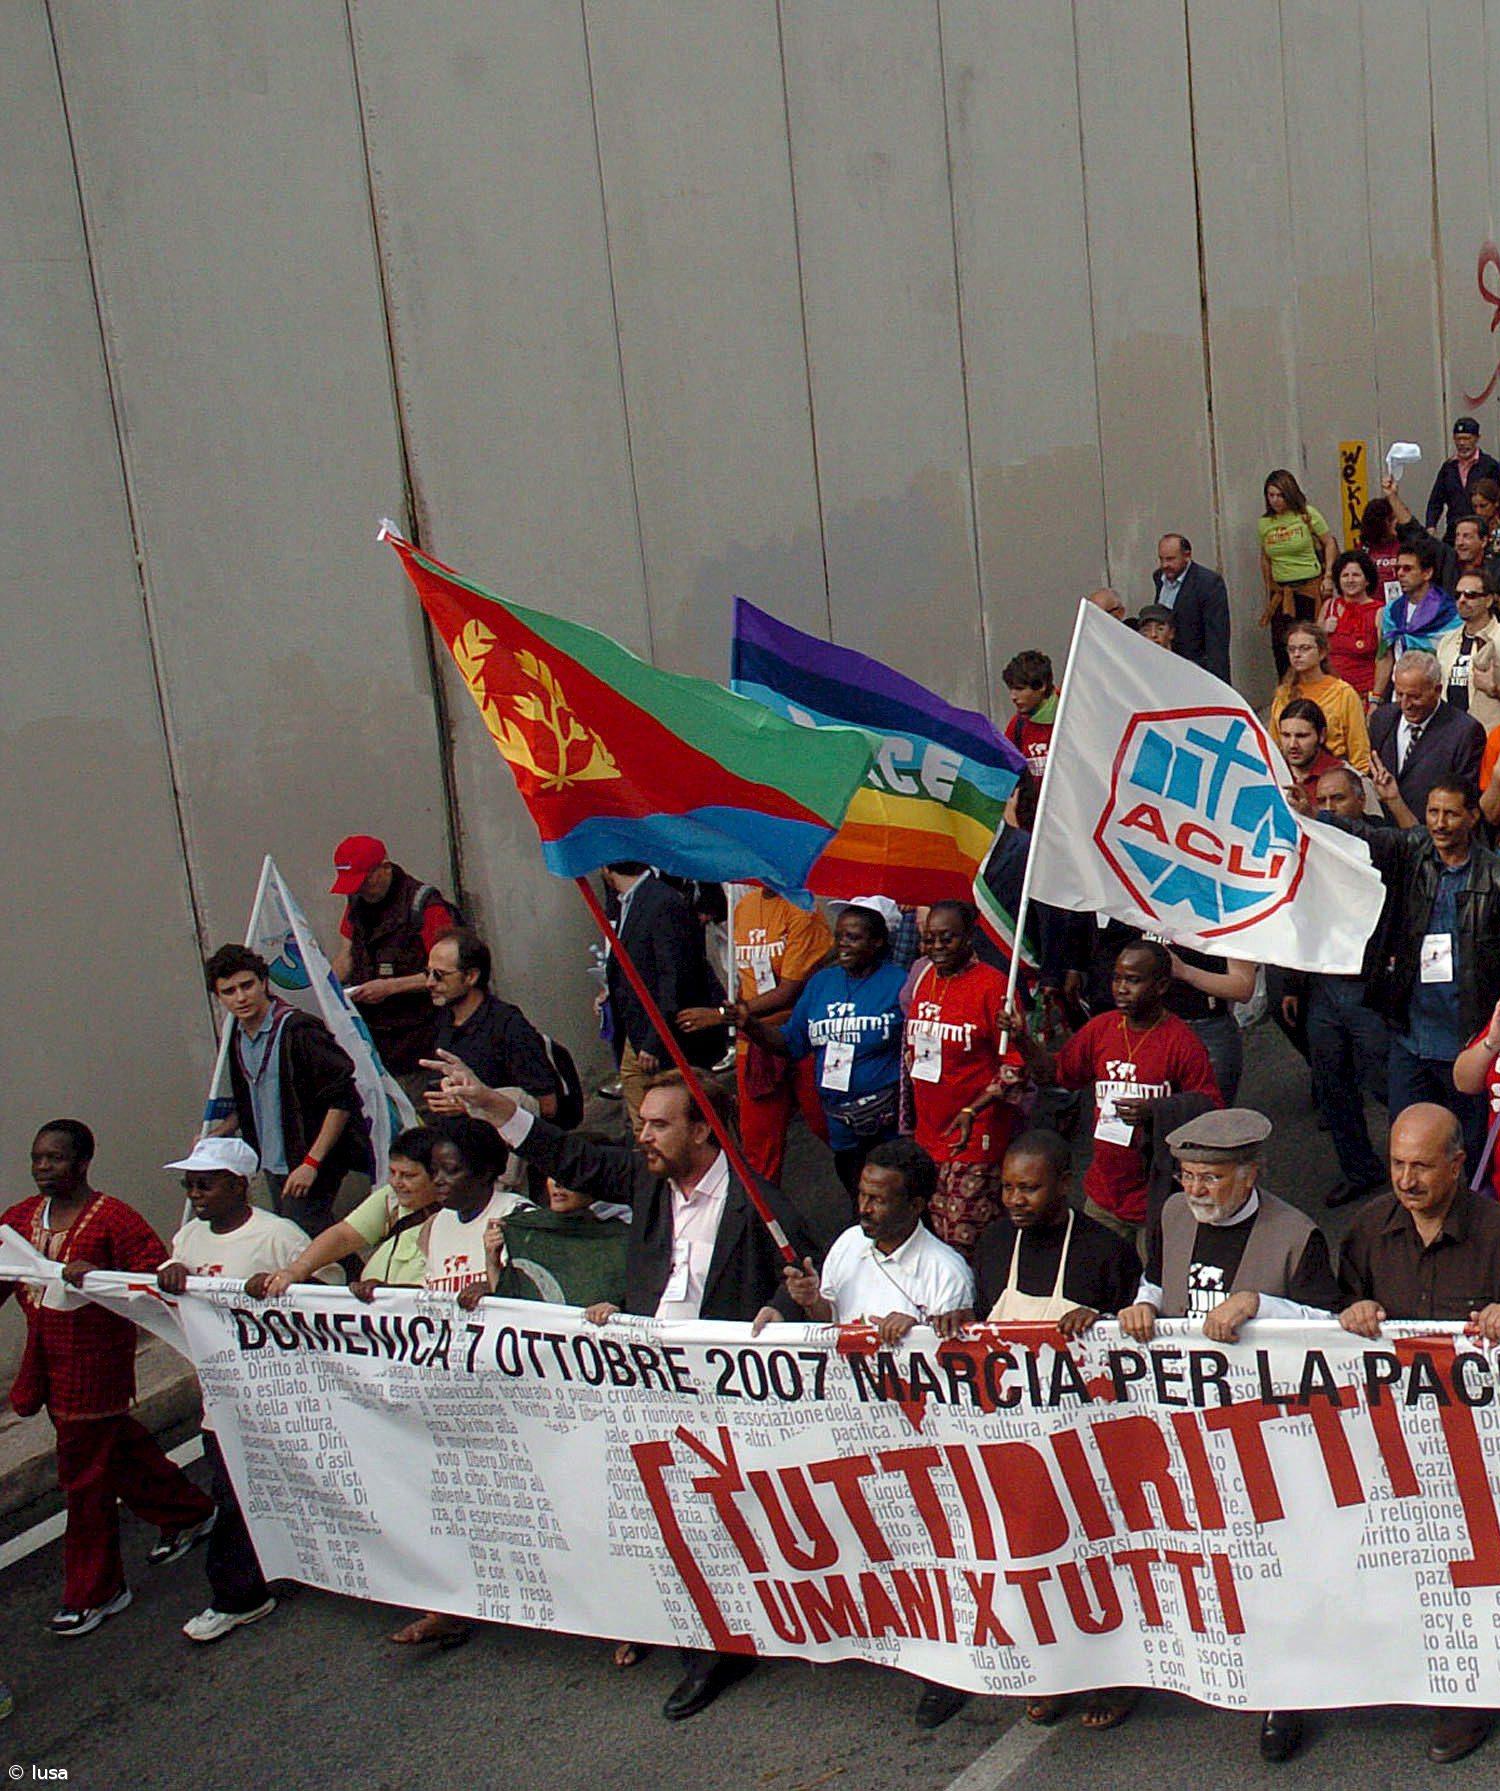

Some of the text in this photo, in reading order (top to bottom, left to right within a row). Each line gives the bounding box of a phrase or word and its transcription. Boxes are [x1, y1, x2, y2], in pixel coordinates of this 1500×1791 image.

[1116, 802, 1285, 881] ACLI
[230, 1308, 452, 1372] DOMENICA
[464, 1323, 486, 1373] 7
[495, 1325, 699, 1396] OTTOBRE
[705, 1348, 829, 1402] 2007
[850, 1350, 1092, 1408] MARCIA
[1109, 1349, 1234, 1407] PER
[1256, 1349, 1342, 1407] LA
[250, 1358, 308, 1378] Diritto al
[256, 1400, 288, 1417] della
[623, 1402, 863, 1426] di riunione e di associazione della
[285, 1415, 338, 1434] cultura,
[831, 1422, 897, 1442] pacifica.
[983, 1421, 1048, 1441] cultura,
[1381, 1503, 1462, 1524] religione
[1416, 1522, 1449, 1542] alla
[1446, 1631, 1478, 1650] alla
